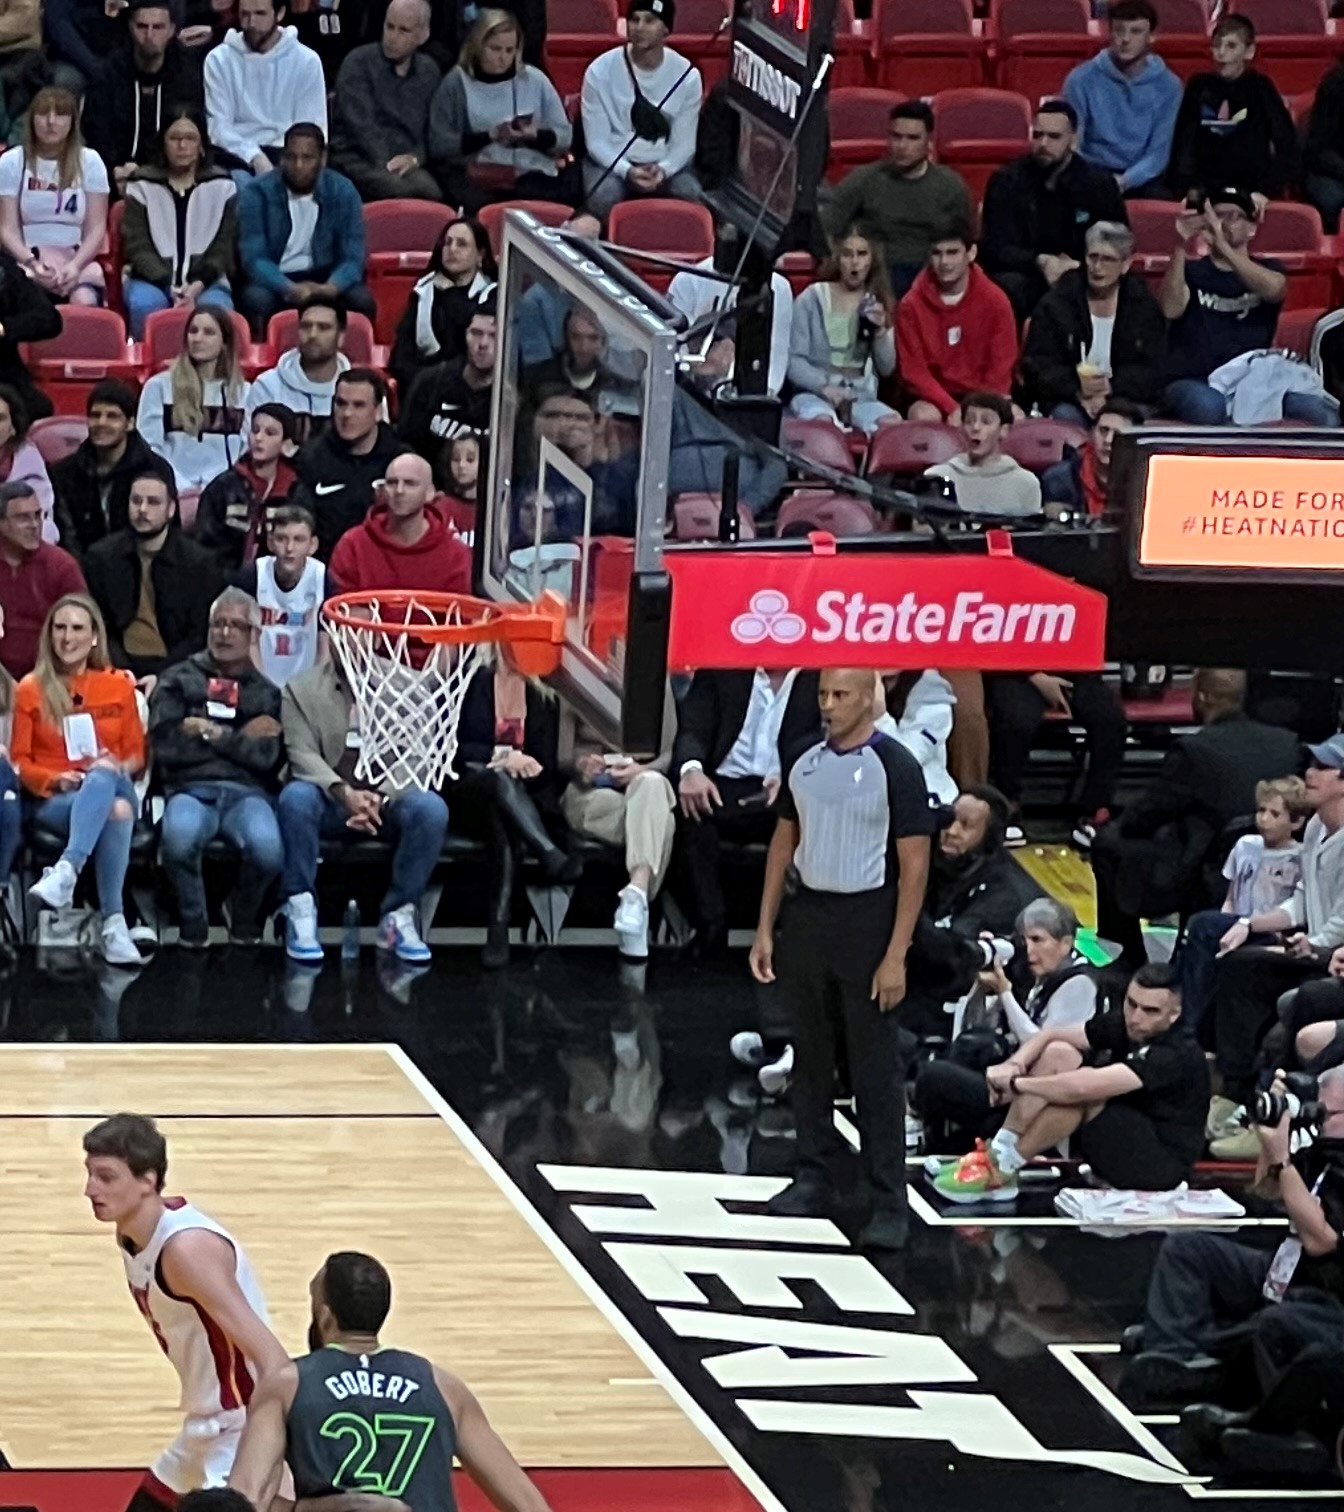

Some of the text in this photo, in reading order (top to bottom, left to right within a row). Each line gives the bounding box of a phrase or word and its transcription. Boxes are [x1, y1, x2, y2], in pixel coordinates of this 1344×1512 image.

[1211, 490, 1344, 511] MADE FOR
[535, 1163, 1214, 1486] HEAT
[324, 1370, 420, 1403] GOBERT
[320, 1412, 436, 1496] 27
